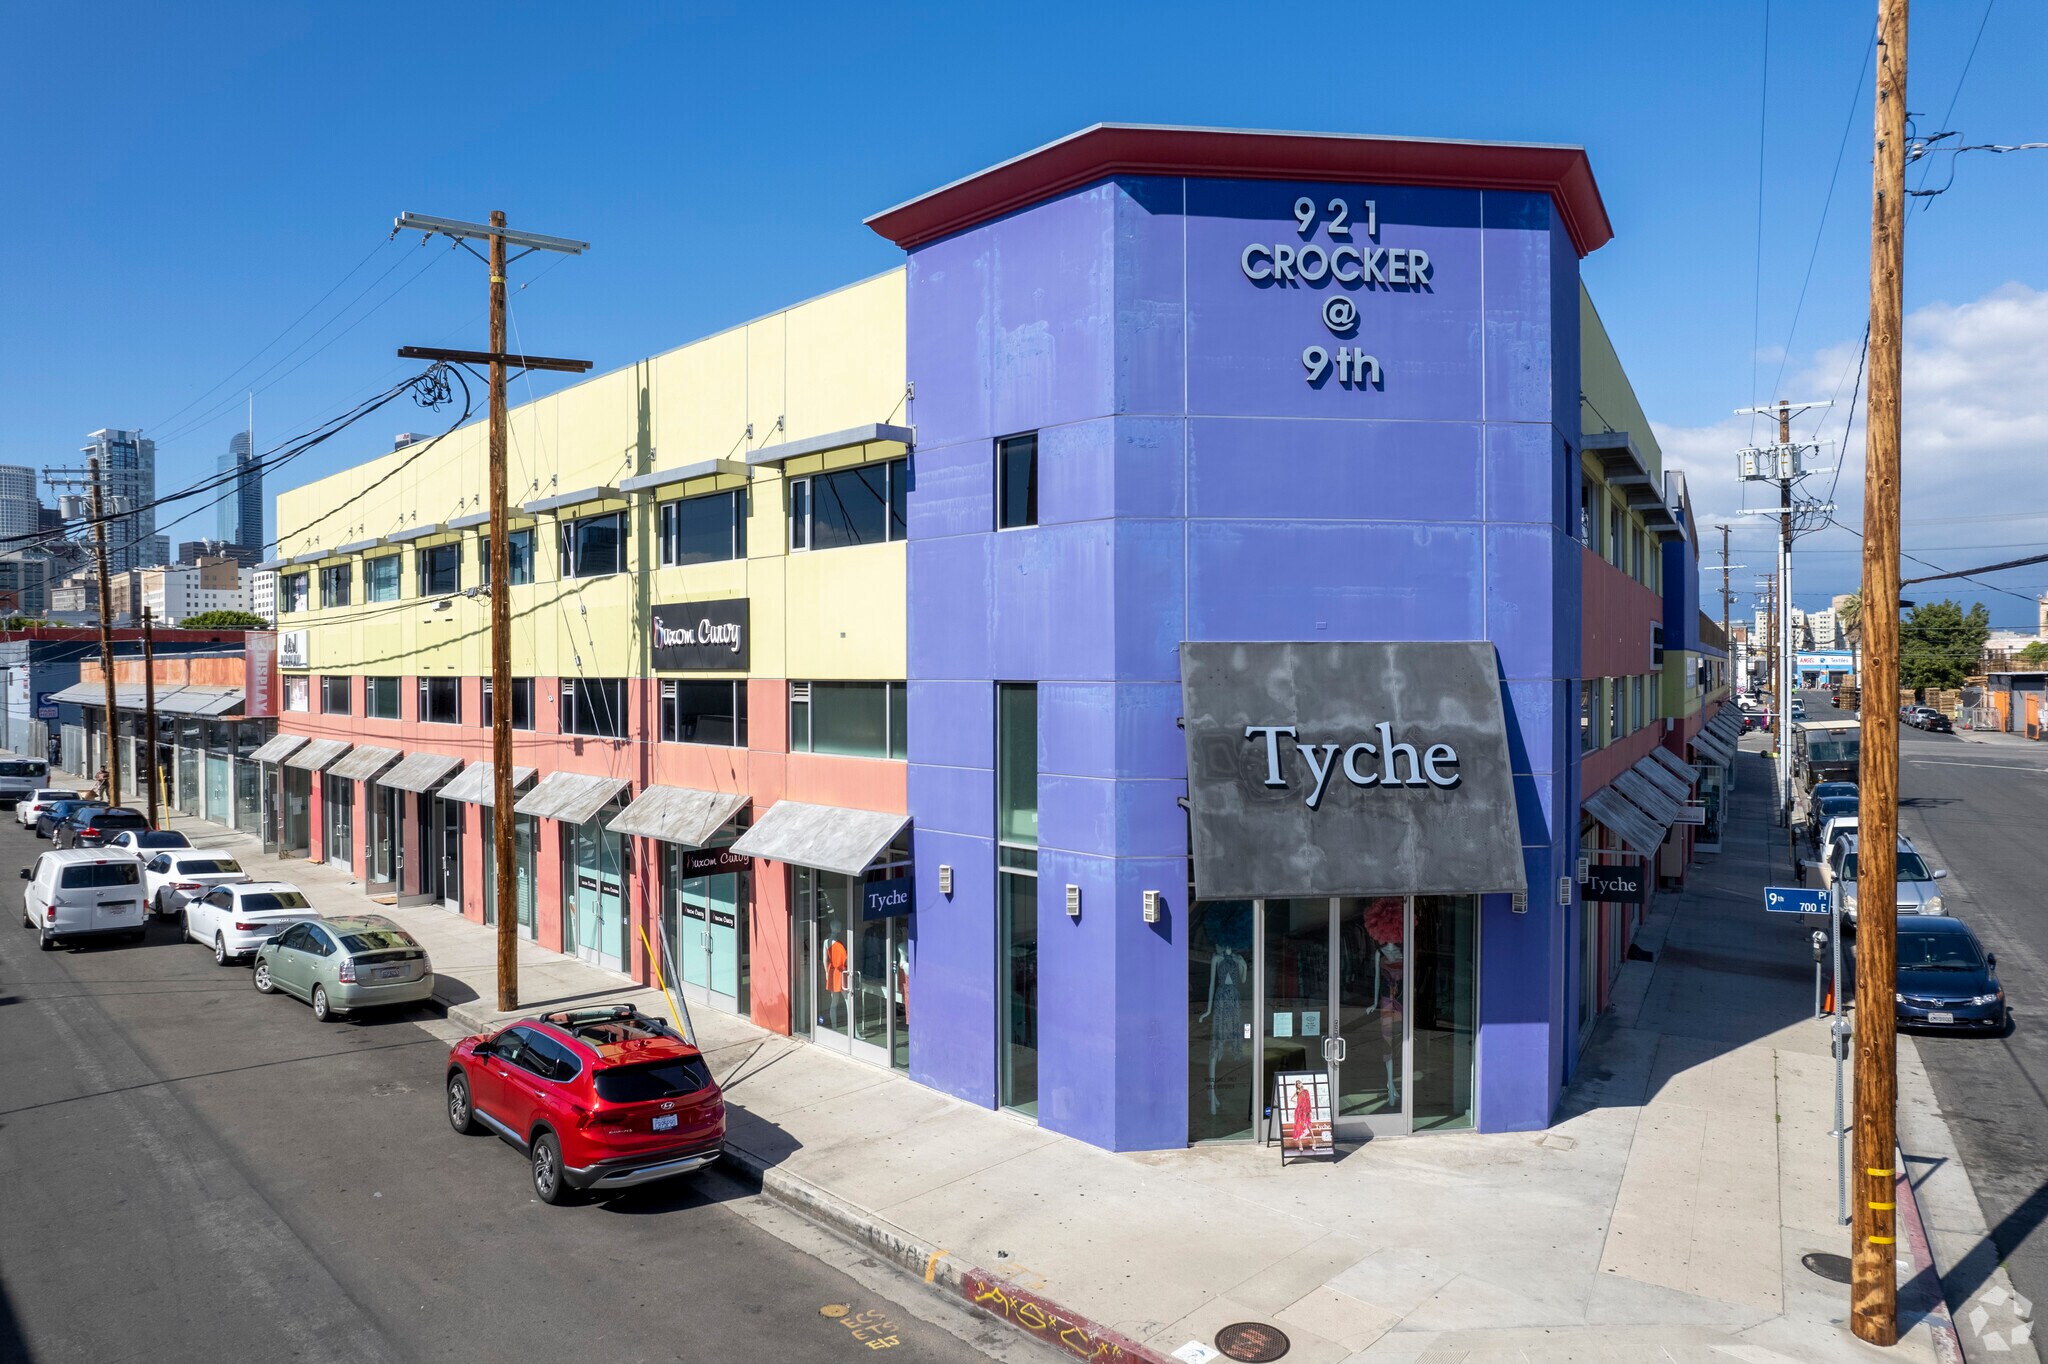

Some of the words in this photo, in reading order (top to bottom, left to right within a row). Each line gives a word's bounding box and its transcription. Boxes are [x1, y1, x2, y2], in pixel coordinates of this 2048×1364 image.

[1294, 196, 1376, 235] 921
[1241, 243, 1430, 285] CROCKER
[1322, 295, 1357, 332] @
[1302, 345, 1381, 384] 9th
[698, 618, 741, 652] Curvy
[255, 650, 268, 711] DISPLAY
[1245, 721, 1460, 807] Tyche
[868, 889, 908, 911] Tyche
[1587, 876, 1637, 894] Tyche
[1768, 892, 1784, 905] 9th
[1799, 902, 1817, 912] 700
[1821, 903, 1827, 912] E
